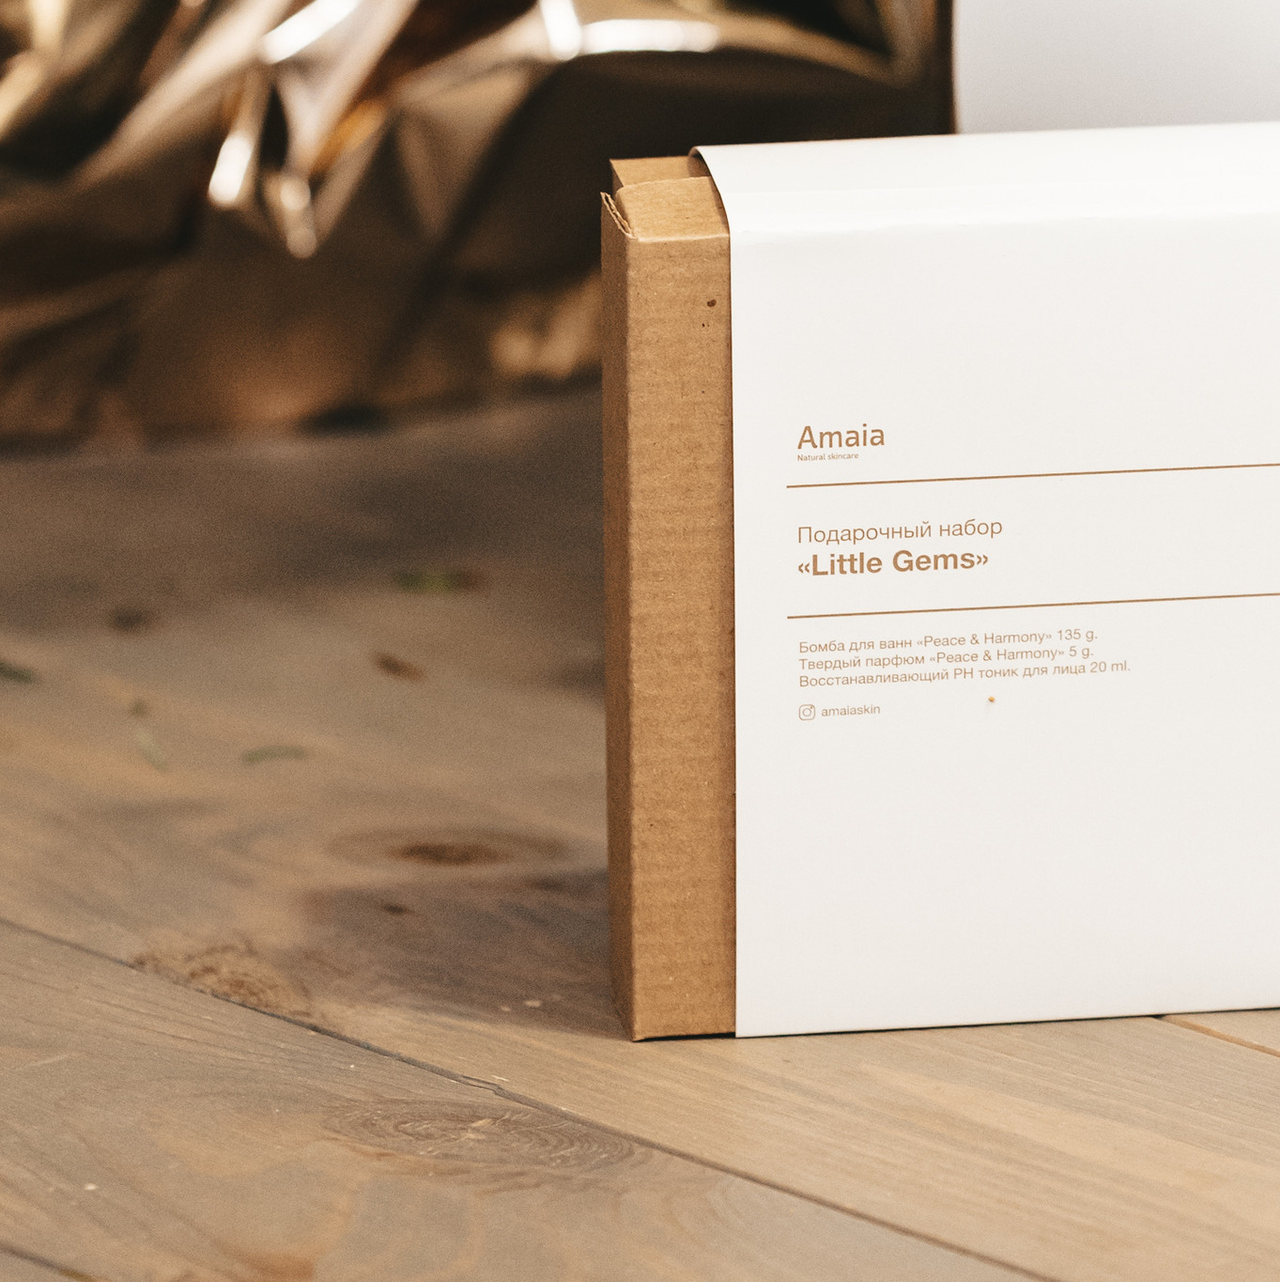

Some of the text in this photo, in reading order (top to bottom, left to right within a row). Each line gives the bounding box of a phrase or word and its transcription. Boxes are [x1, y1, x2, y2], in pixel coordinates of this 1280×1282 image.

[797, 423, 885, 450] Amaia
[798, 518, 1002, 545] Подарочный набор
[798, 550, 988, 576] «Little Gems»
[800, 629, 1097, 653] Бомба для ванн «Peace & Harmony» 135 g.
[799, 646, 1093, 671] Твердый парфюм «Peace & Harmony» 5 g.
[800, 669, 949, 687] Восстанавливающий
[978, 668, 1018, 678] тоник
[1022, 667, 1048, 678] для
[1053, 665, 1085, 675] лица
[1090, 661, 1106, 673] 20
[1111, 660, 1130, 671] ml.
[821, 705, 880, 717] amaiaskin
